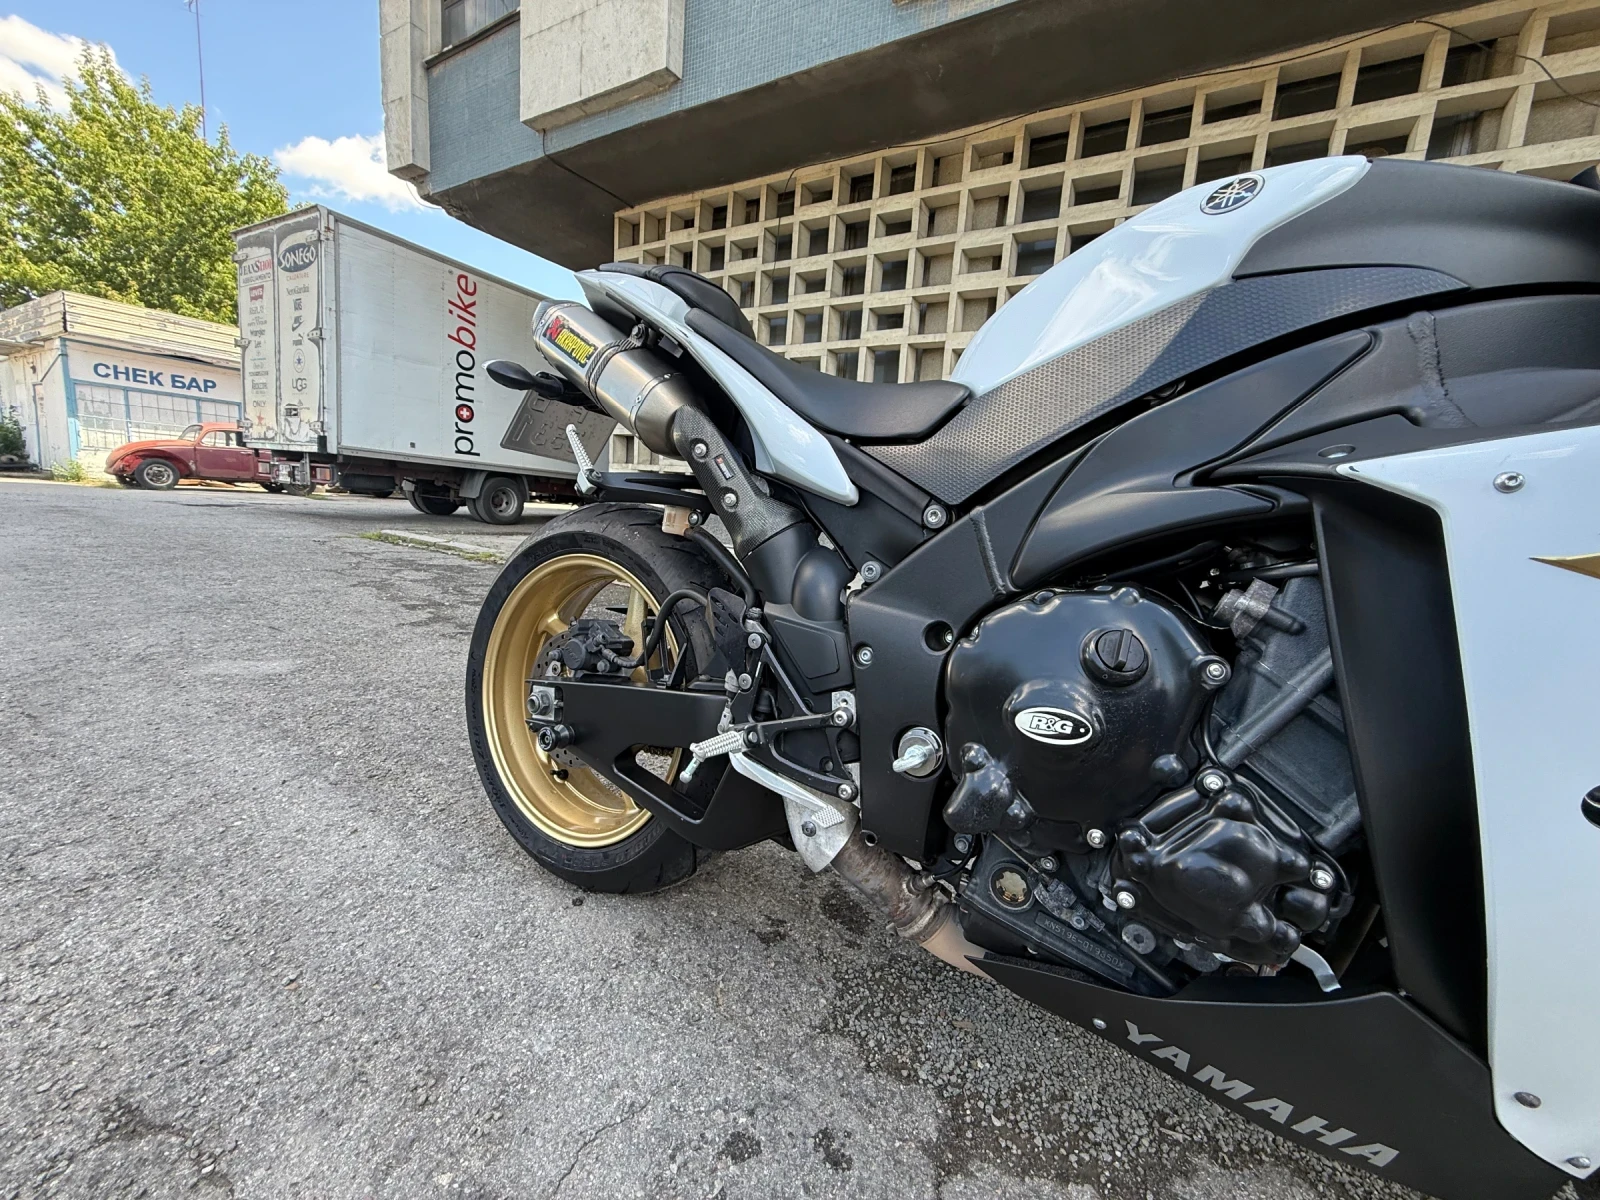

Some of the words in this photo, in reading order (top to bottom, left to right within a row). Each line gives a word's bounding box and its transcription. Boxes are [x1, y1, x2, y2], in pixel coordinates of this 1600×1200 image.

[279, 245, 316, 269] SONEGO
[93, 362, 164, 387] СНЕК
[170, 374, 217, 393] БАР
[448, 274, 480, 456] promobike
[292, 378, 307, 392] UGG
[1029, 715, 1074, 735] R&G
[1124, 1019, 1400, 1168] YAMAHA
